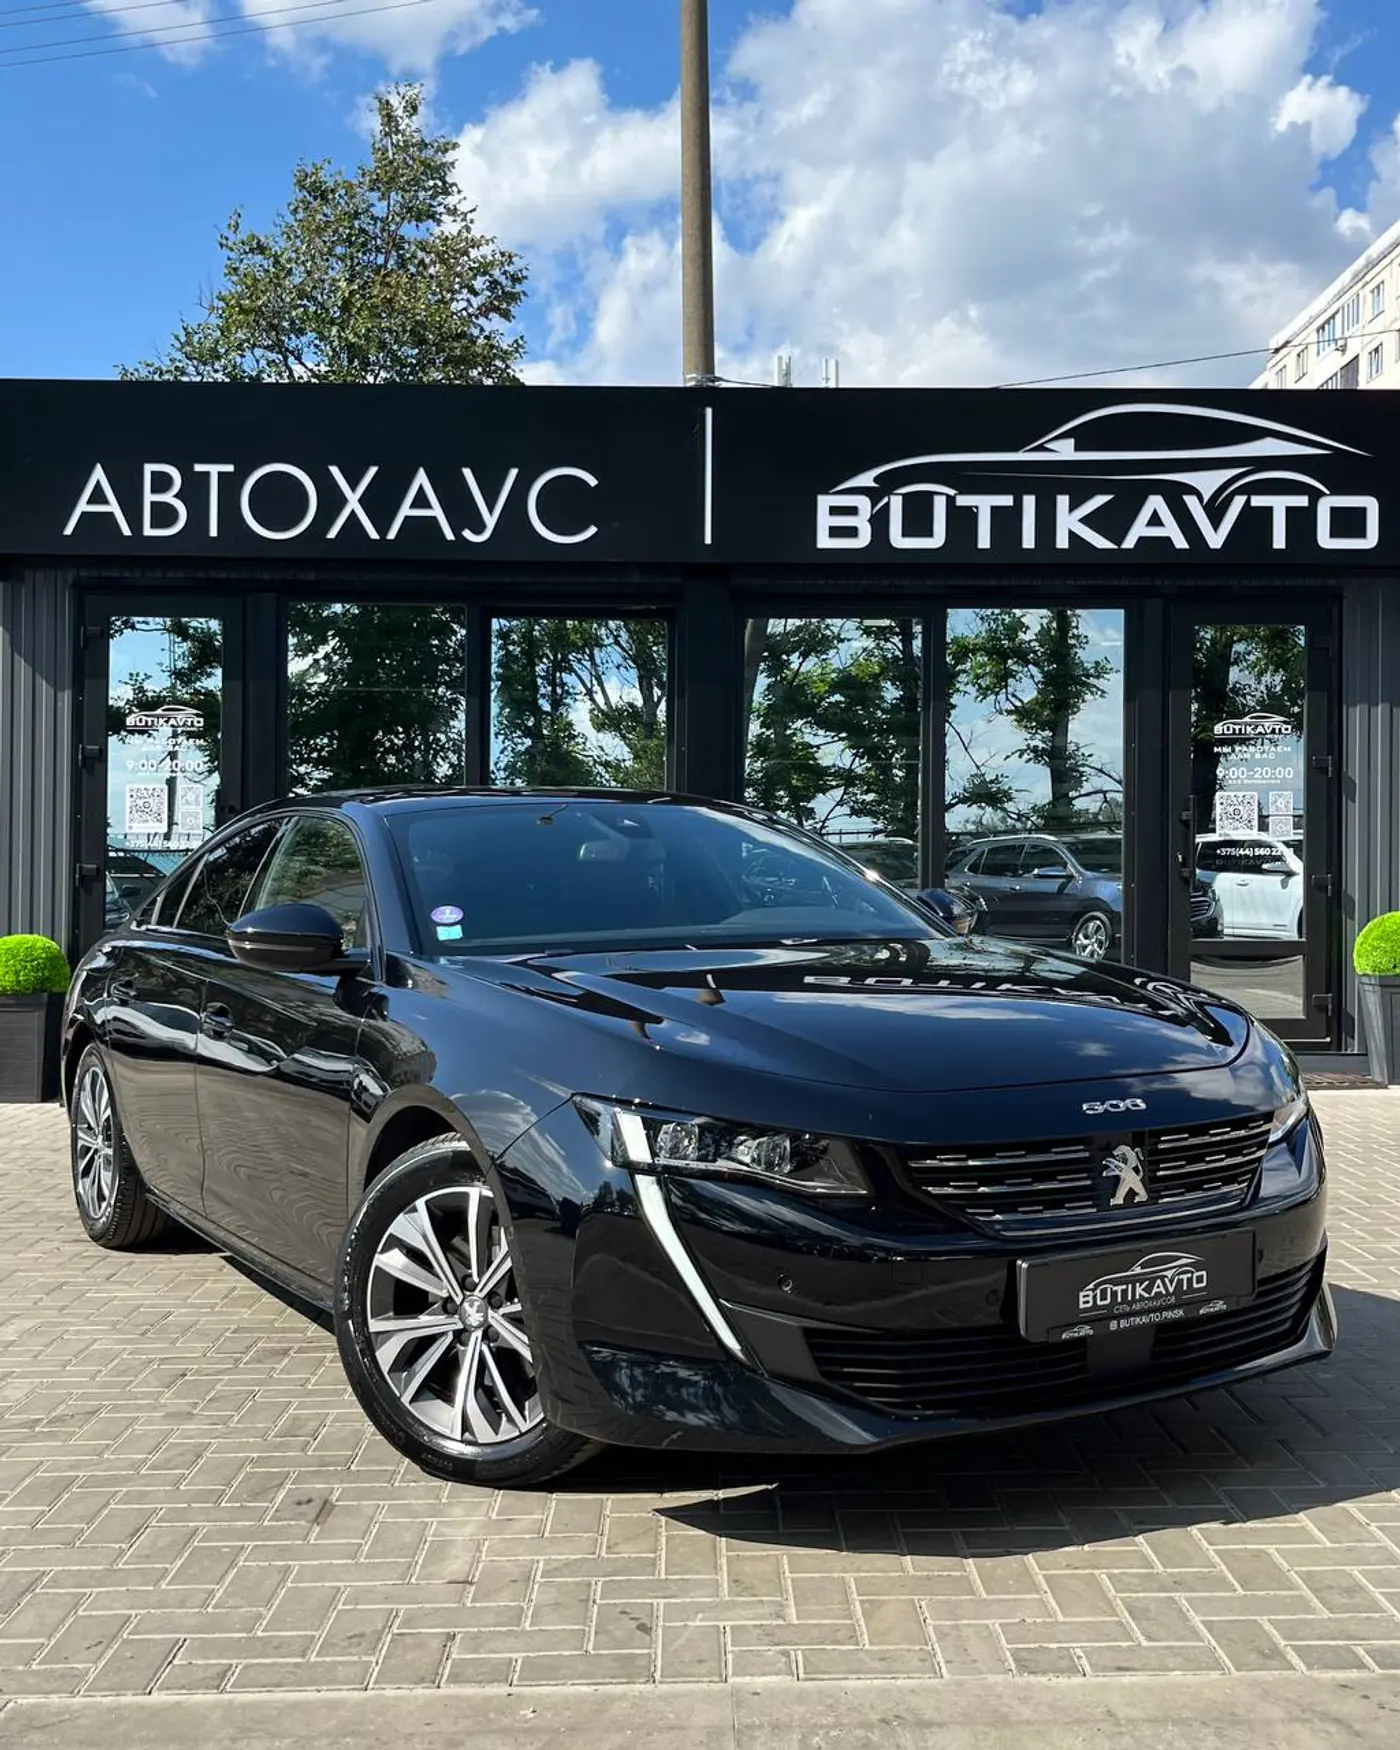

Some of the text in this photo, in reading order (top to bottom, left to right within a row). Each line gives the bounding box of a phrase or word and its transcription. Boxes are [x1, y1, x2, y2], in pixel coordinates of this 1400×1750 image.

[62, 462, 600, 545] АВТОХАУС
[816, 493, 1380, 550] BUTIKAVTO
[126, 717, 204, 726] BUTIKAVTO
[1213, 724, 1292, 734] BUTIKAVTO
[1216, 766, 1294, 779] 9:00-20:00
[1082, 1098, 1147, 1114] 508
[1078, 1271, 1207, 1309] BUTIKAVTO
